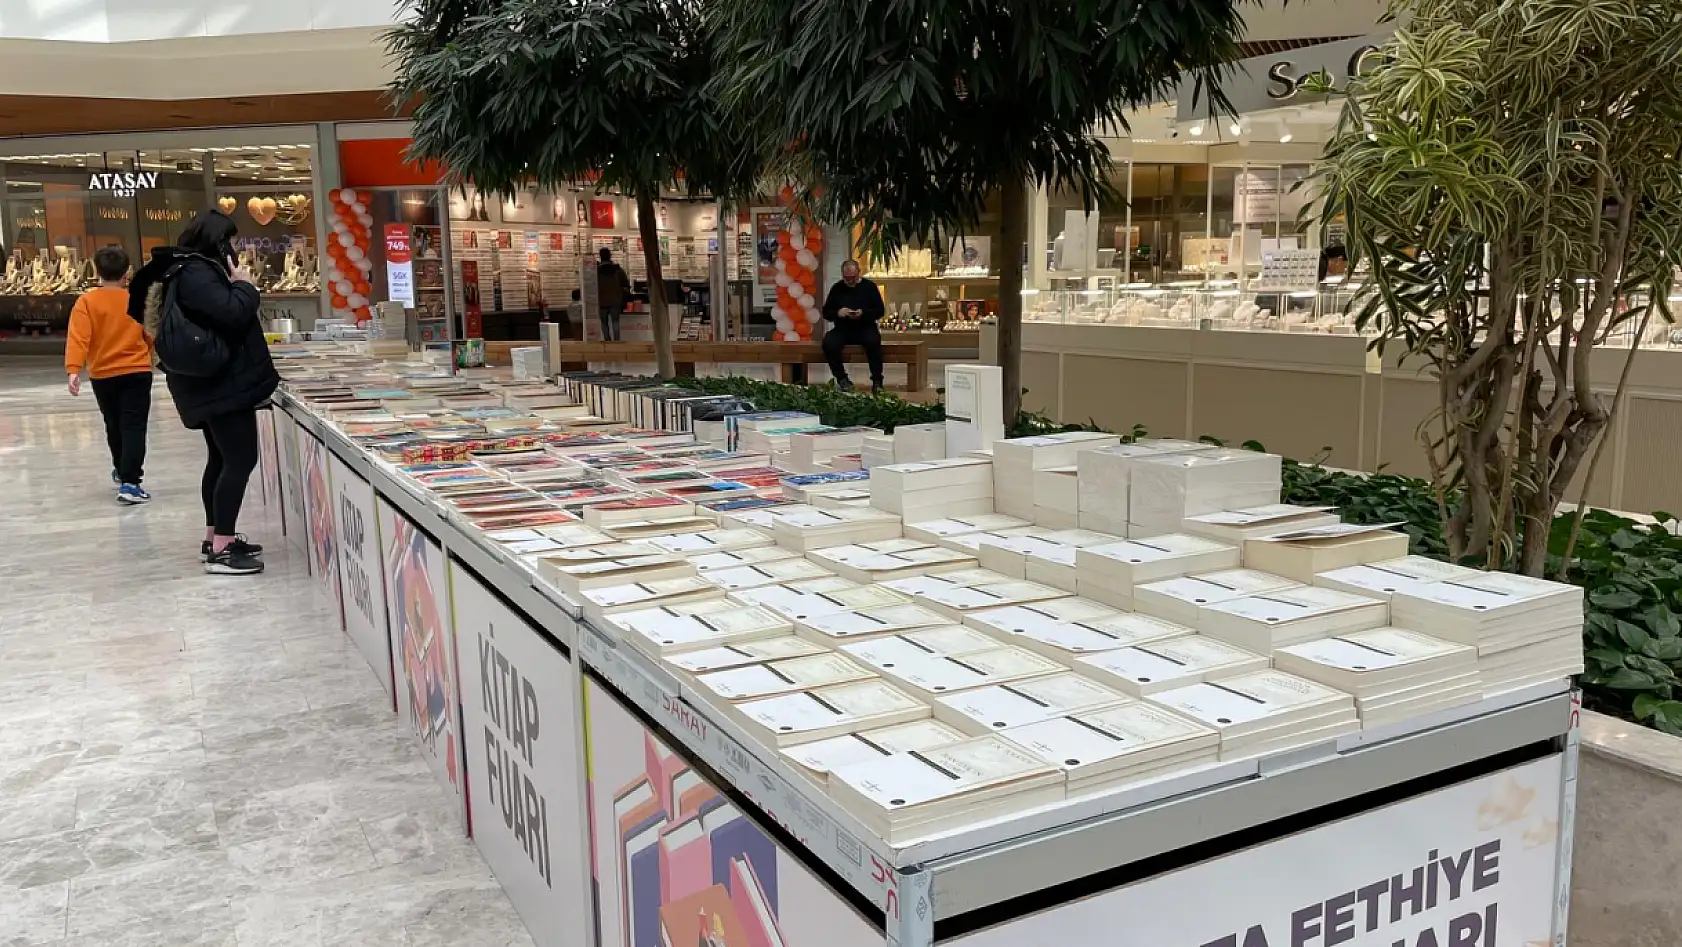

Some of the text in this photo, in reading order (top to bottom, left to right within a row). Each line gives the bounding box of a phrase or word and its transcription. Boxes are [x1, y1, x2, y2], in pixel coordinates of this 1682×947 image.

[89, 172, 159, 190] ATASAY
[478, 622, 540, 769] KİTAP
[484, 724, 551, 889] FUARI
[1290, 839, 1501, 947] FETHİYE
